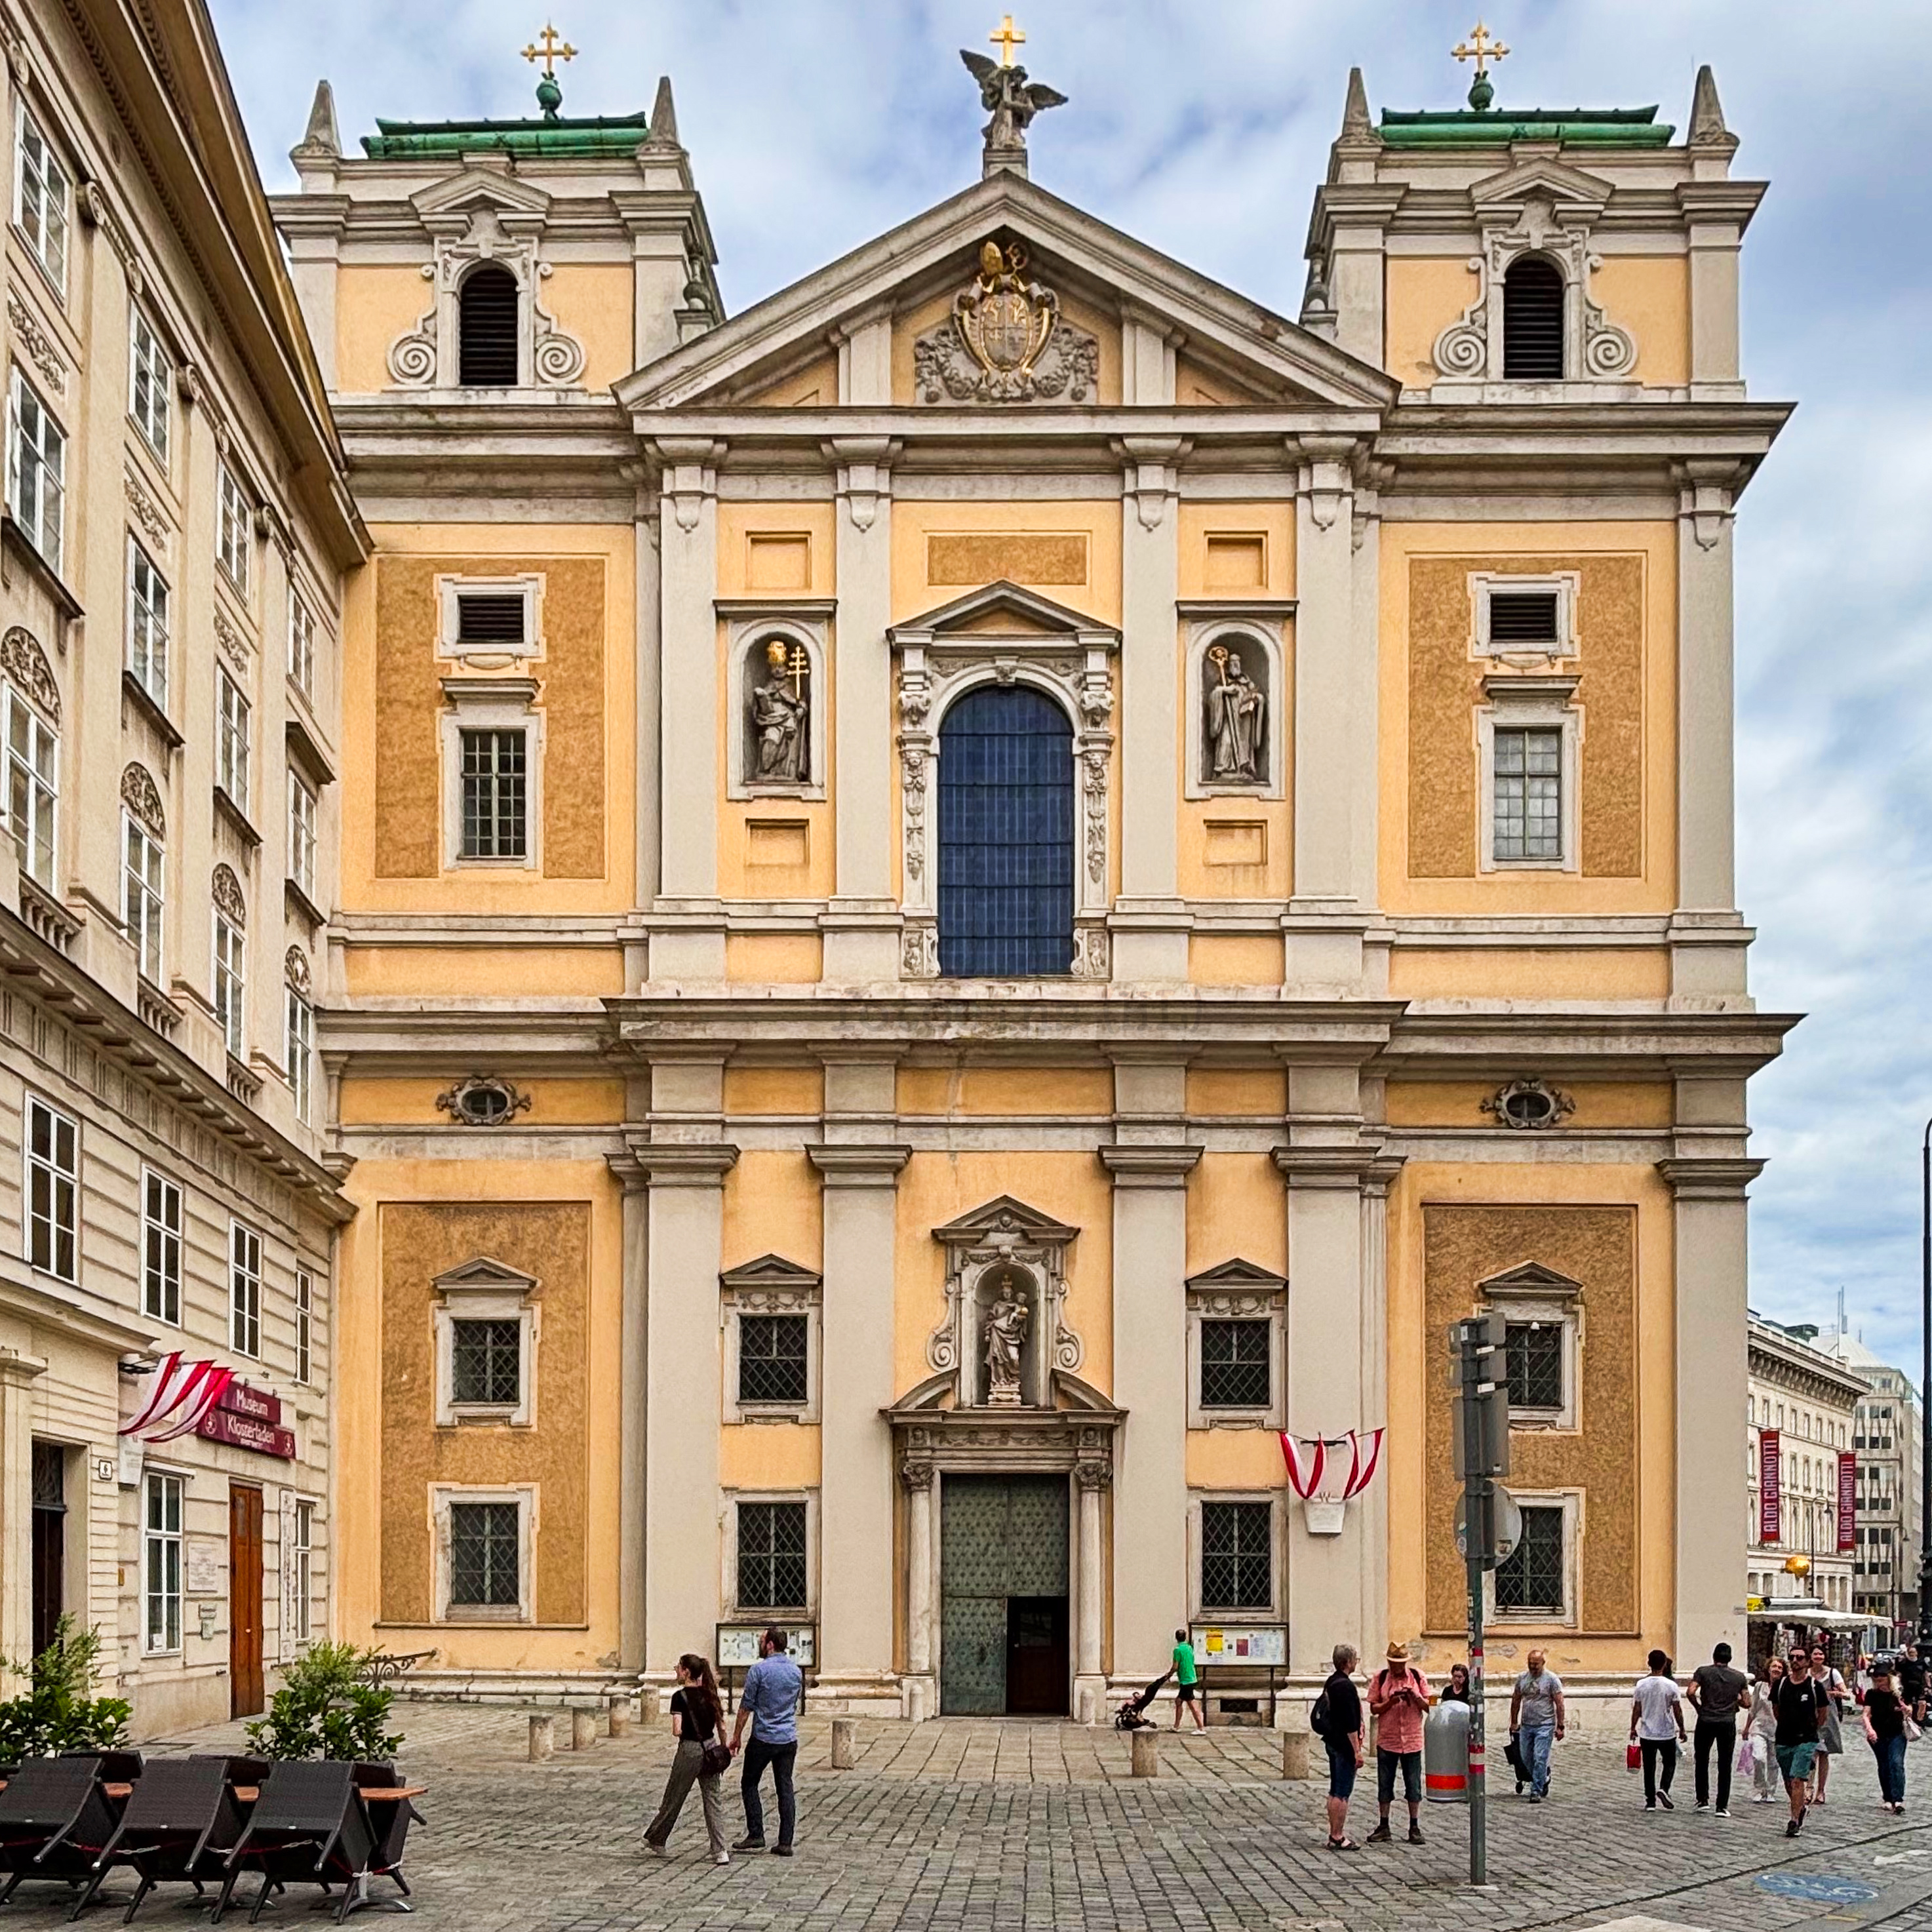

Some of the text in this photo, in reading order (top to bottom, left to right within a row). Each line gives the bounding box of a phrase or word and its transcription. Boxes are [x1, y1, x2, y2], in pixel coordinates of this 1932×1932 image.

[227, 1413, 275, 1445] Klosterladen
[236, 1389, 268, 1417] Museum
[1763, 1439, 1778, 1532] ALDO GIANNOTTI
[1840, 1461, 1854, 1542] ALDO GIANNOTTI
